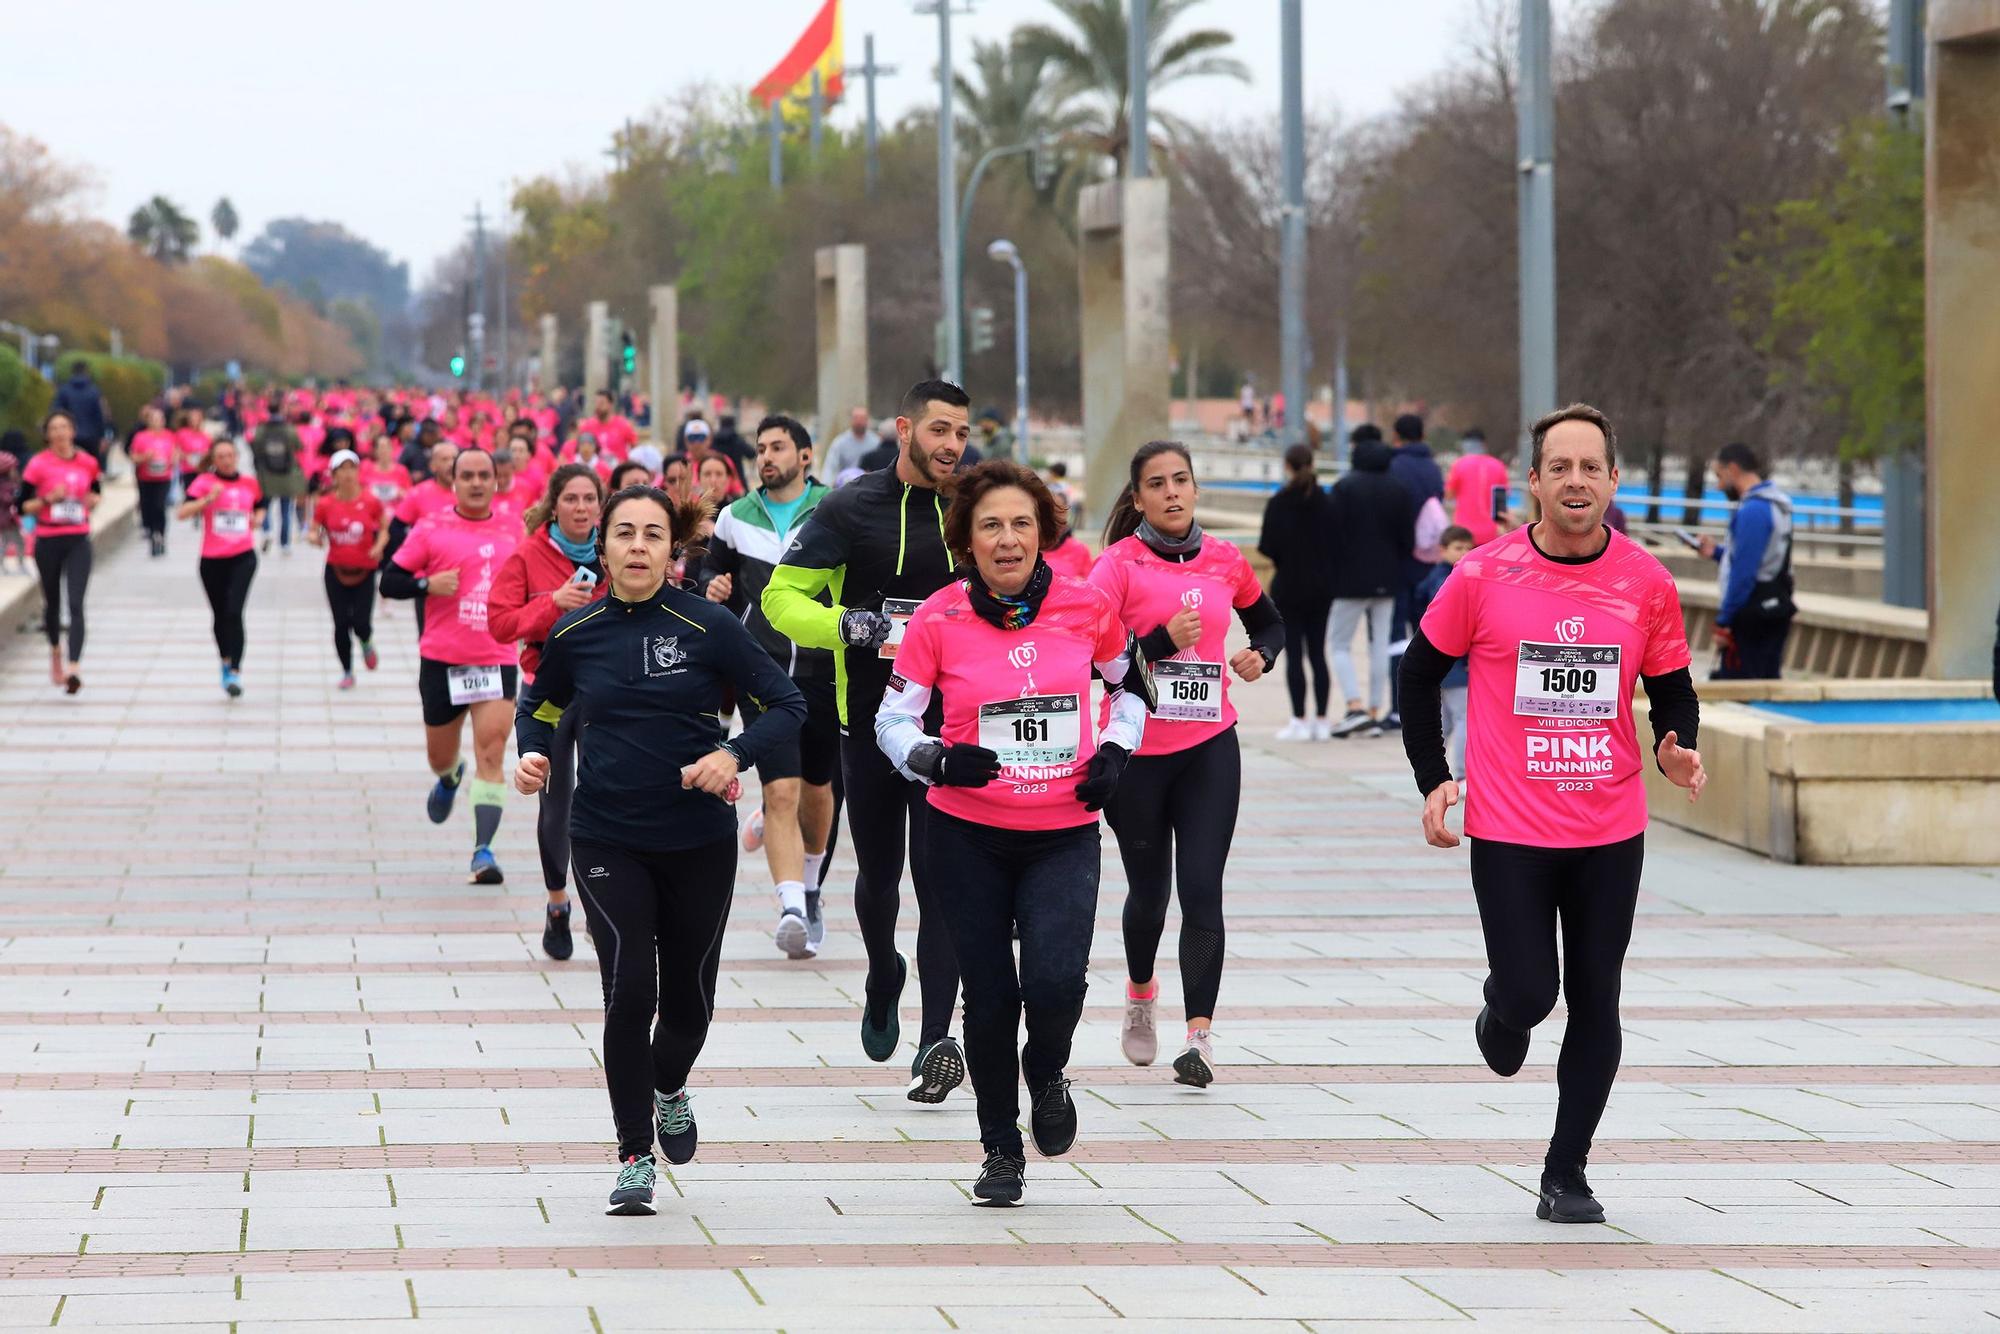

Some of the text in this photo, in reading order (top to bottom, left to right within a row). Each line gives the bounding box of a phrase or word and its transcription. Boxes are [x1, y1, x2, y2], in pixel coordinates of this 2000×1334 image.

[459, 600, 487, 617] PIN
[1540, 668, 1597, 693] 1509
[1171, 681, 1208, 701] 1580
[1011, 718, 1048, 742] 161
[1537, 719, 1555, 727] VIII
[1526, 735, 1612, 758] PINK
[1527, 759, 1613, 773] RUNNING
[1013, 783, 1048, 793] 2023
[1556, 781, 1594, 792] 2023
